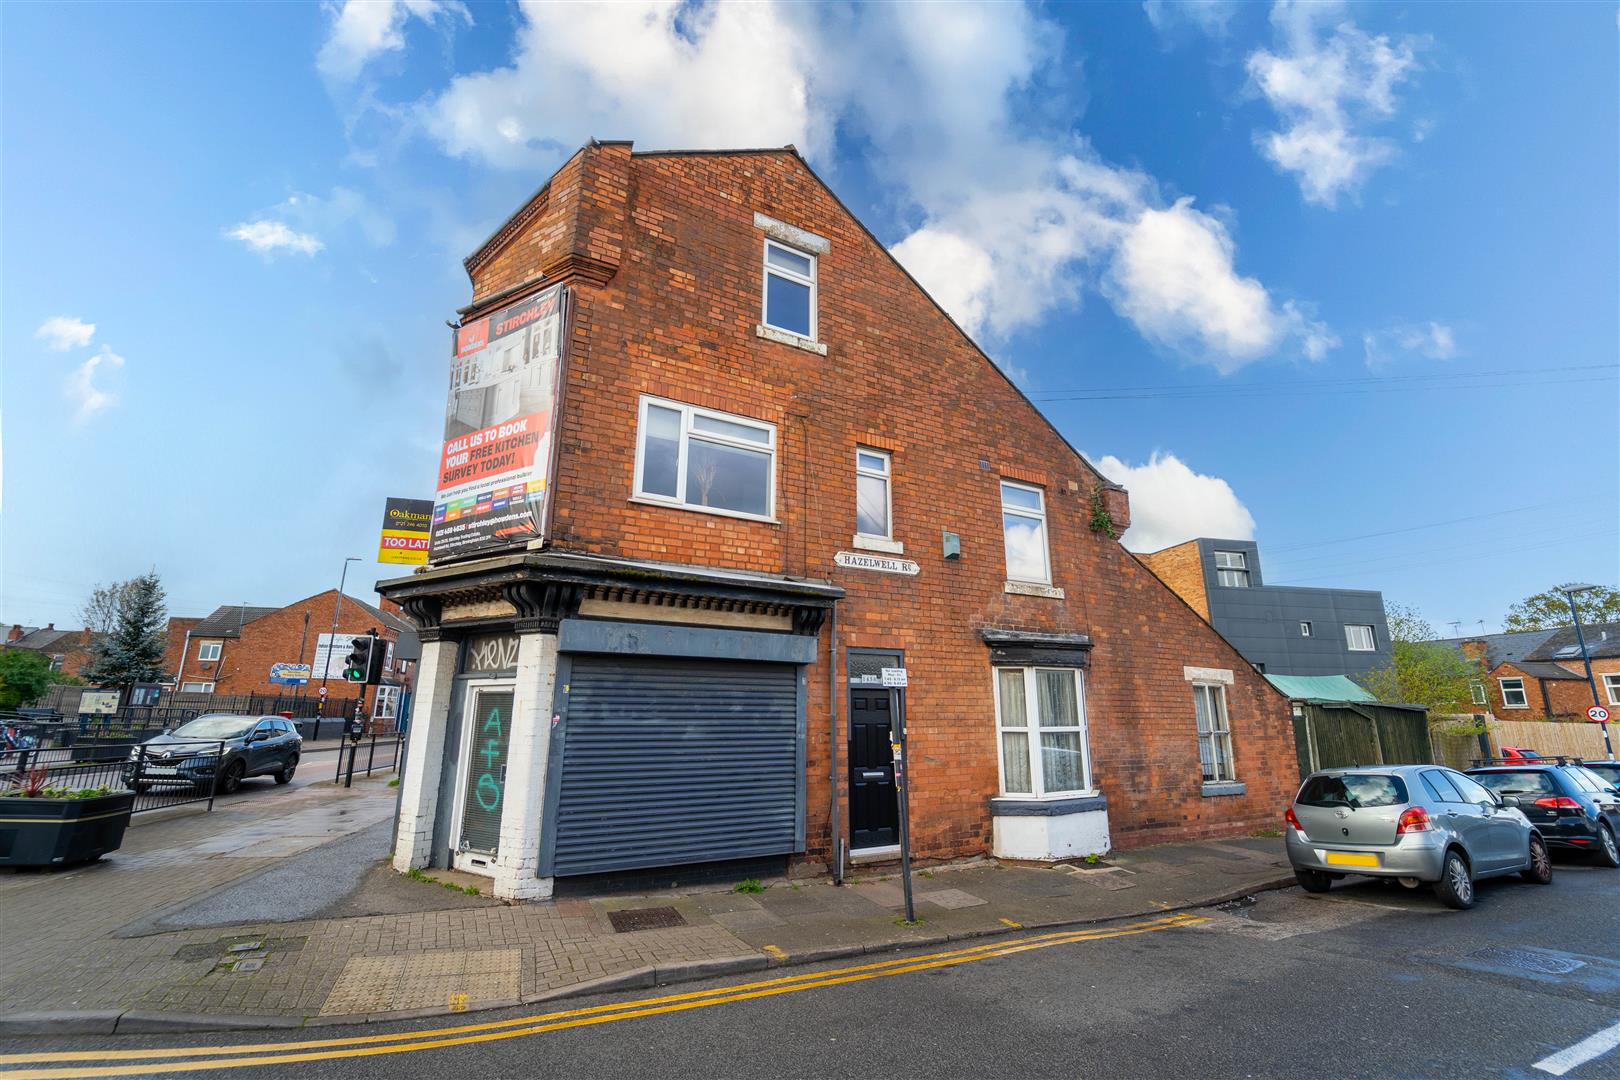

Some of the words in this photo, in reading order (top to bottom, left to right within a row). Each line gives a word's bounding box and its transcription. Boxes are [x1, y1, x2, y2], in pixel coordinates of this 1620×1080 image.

[447, 438, 468, 455] CALL
[470, 433, 483, 447] US
[485, 428, 497, 442] TO
[498, 419, 528, 438] BOOK
[446, 452, 468, 469] YOUR
[470, 444, 493, 461] FREE
[495, 431, 539, 453] KITCHEN
[443, 462, 479, 483] SURVEY
[481, 452, 516, 472] TODAY!
[384, 537, 407, 547] TOO
[844, 555, 898, 570] HAZELWELL
[1589, 709, 1607, 718] 20
